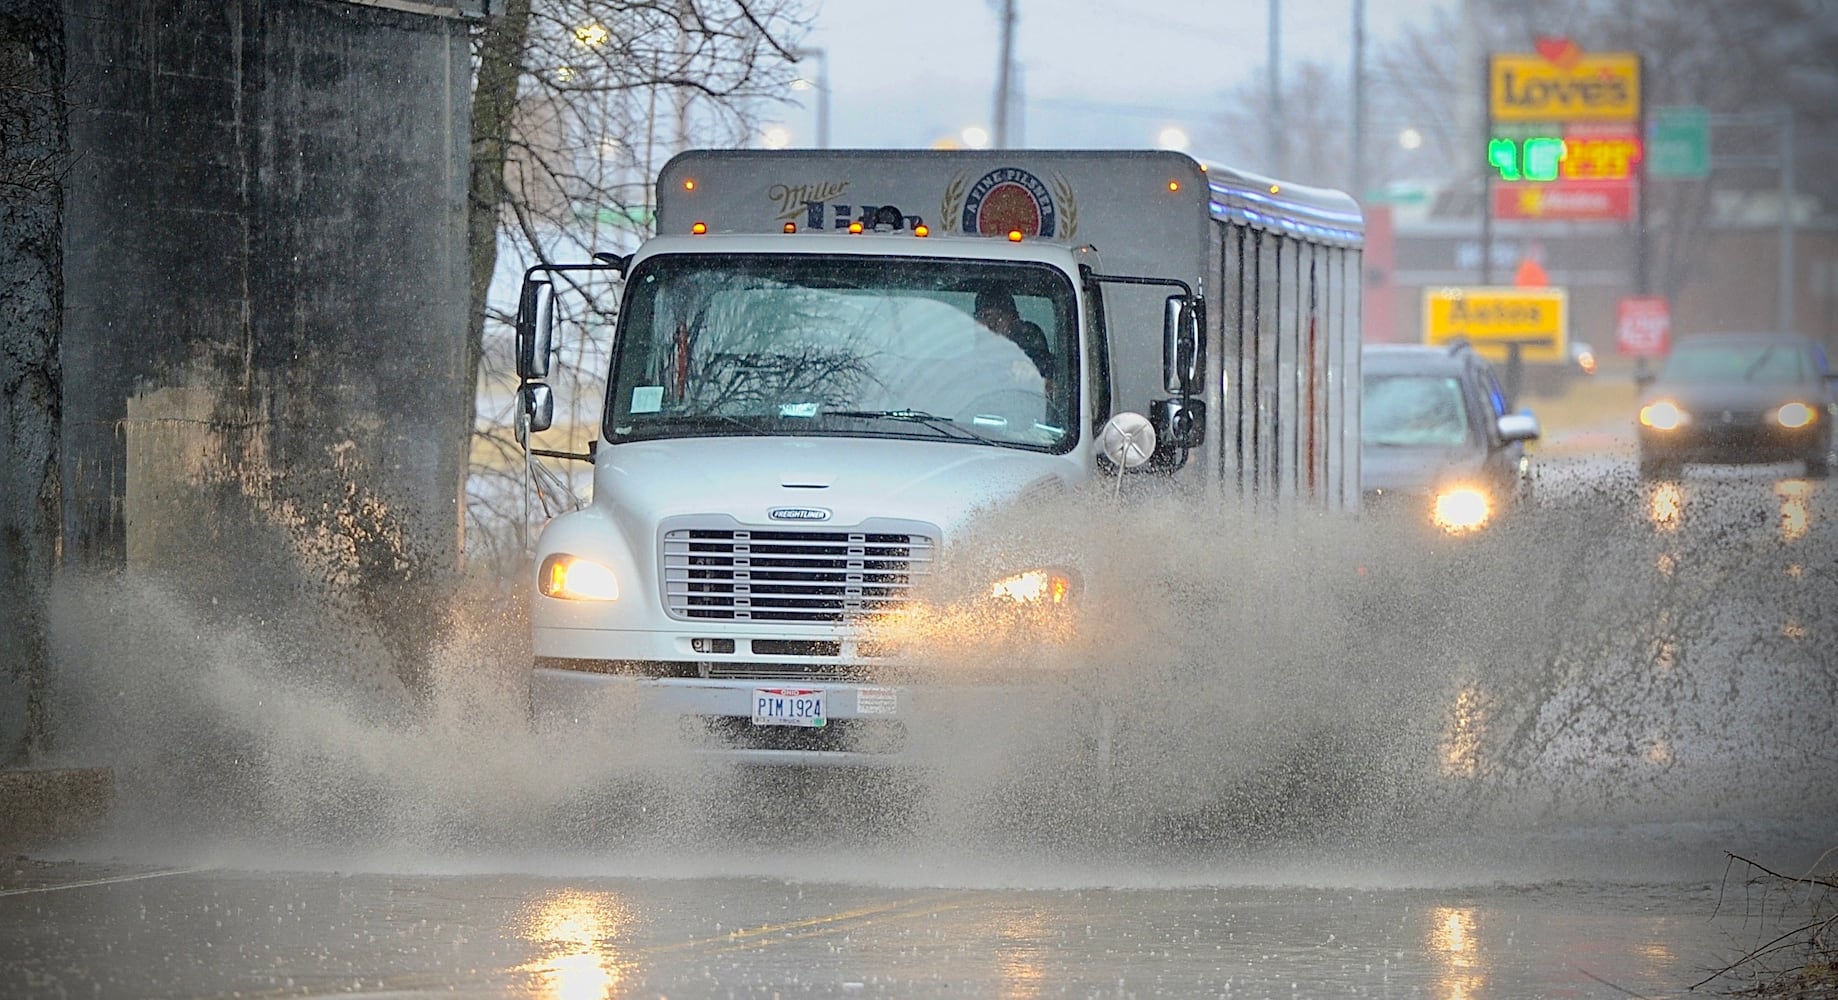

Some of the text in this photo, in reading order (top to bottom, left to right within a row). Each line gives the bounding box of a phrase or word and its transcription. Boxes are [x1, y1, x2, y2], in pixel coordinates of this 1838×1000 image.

[769, 181, 849, 216] Miller
[967, 169, 1052, 215] A FINE PILSNER
[774, 510, 825, 519] FREIGHTLINER
[758, 698, 820, 717] PIM 1924
